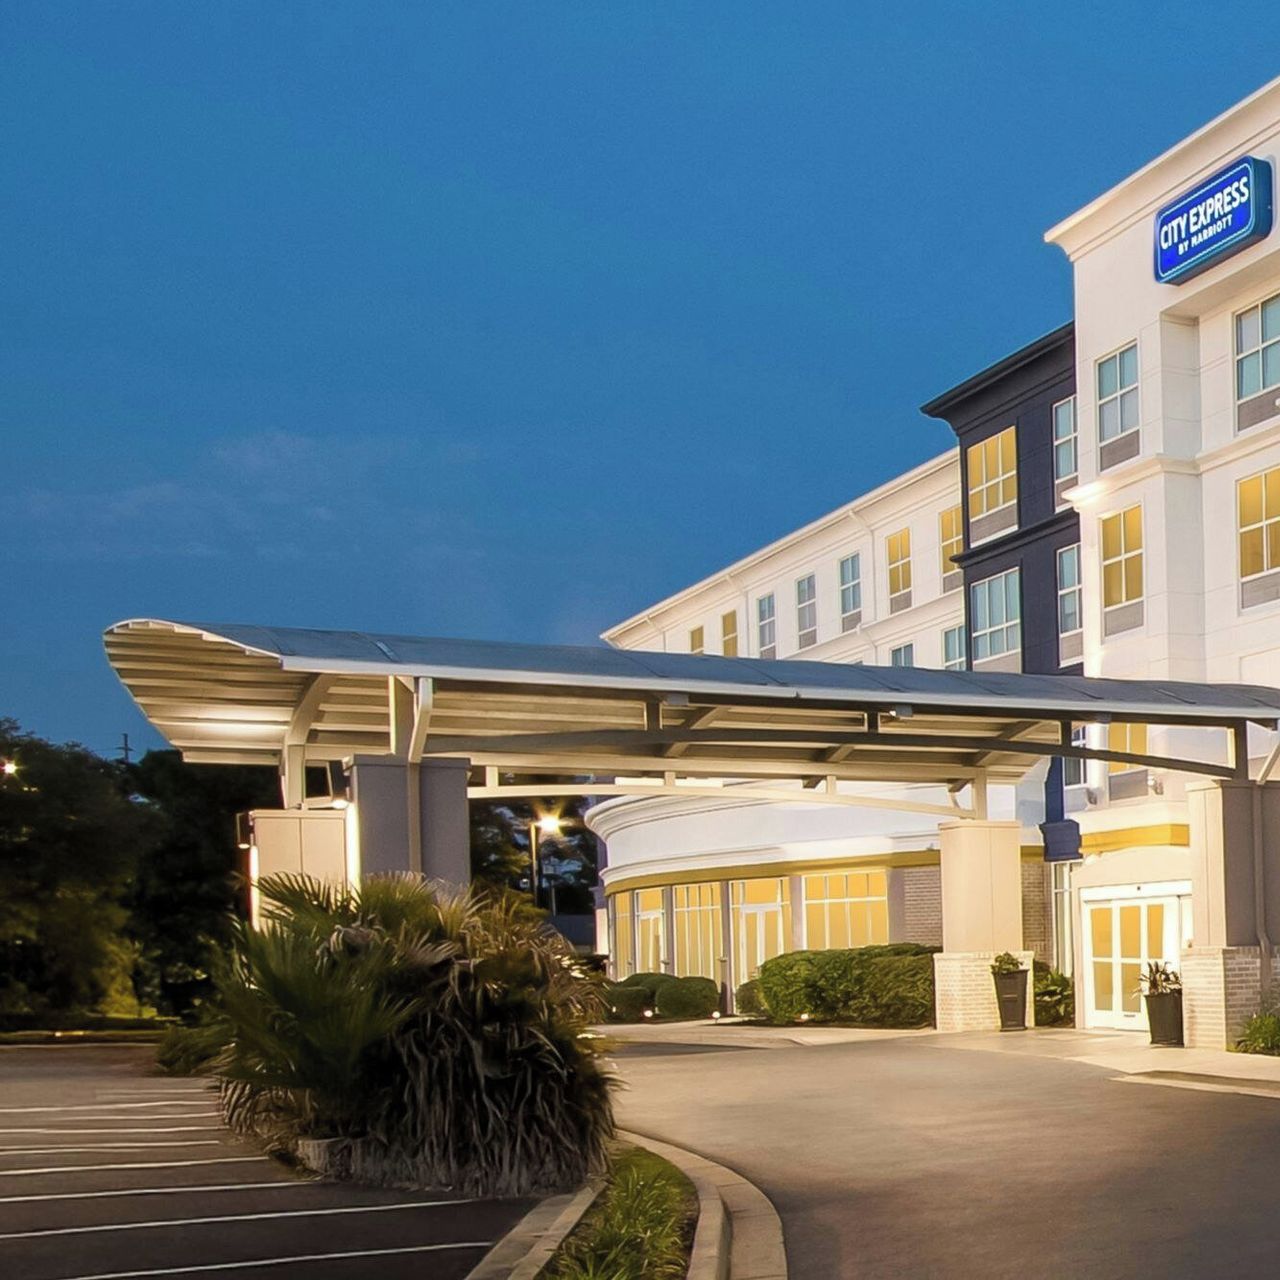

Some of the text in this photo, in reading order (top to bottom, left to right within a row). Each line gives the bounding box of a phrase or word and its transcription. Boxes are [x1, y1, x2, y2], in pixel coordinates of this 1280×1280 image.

[1160, 176, 1249, 250] CITY EXPRESS
[1178, 214, 1233, 255] BY MARRIOTT
